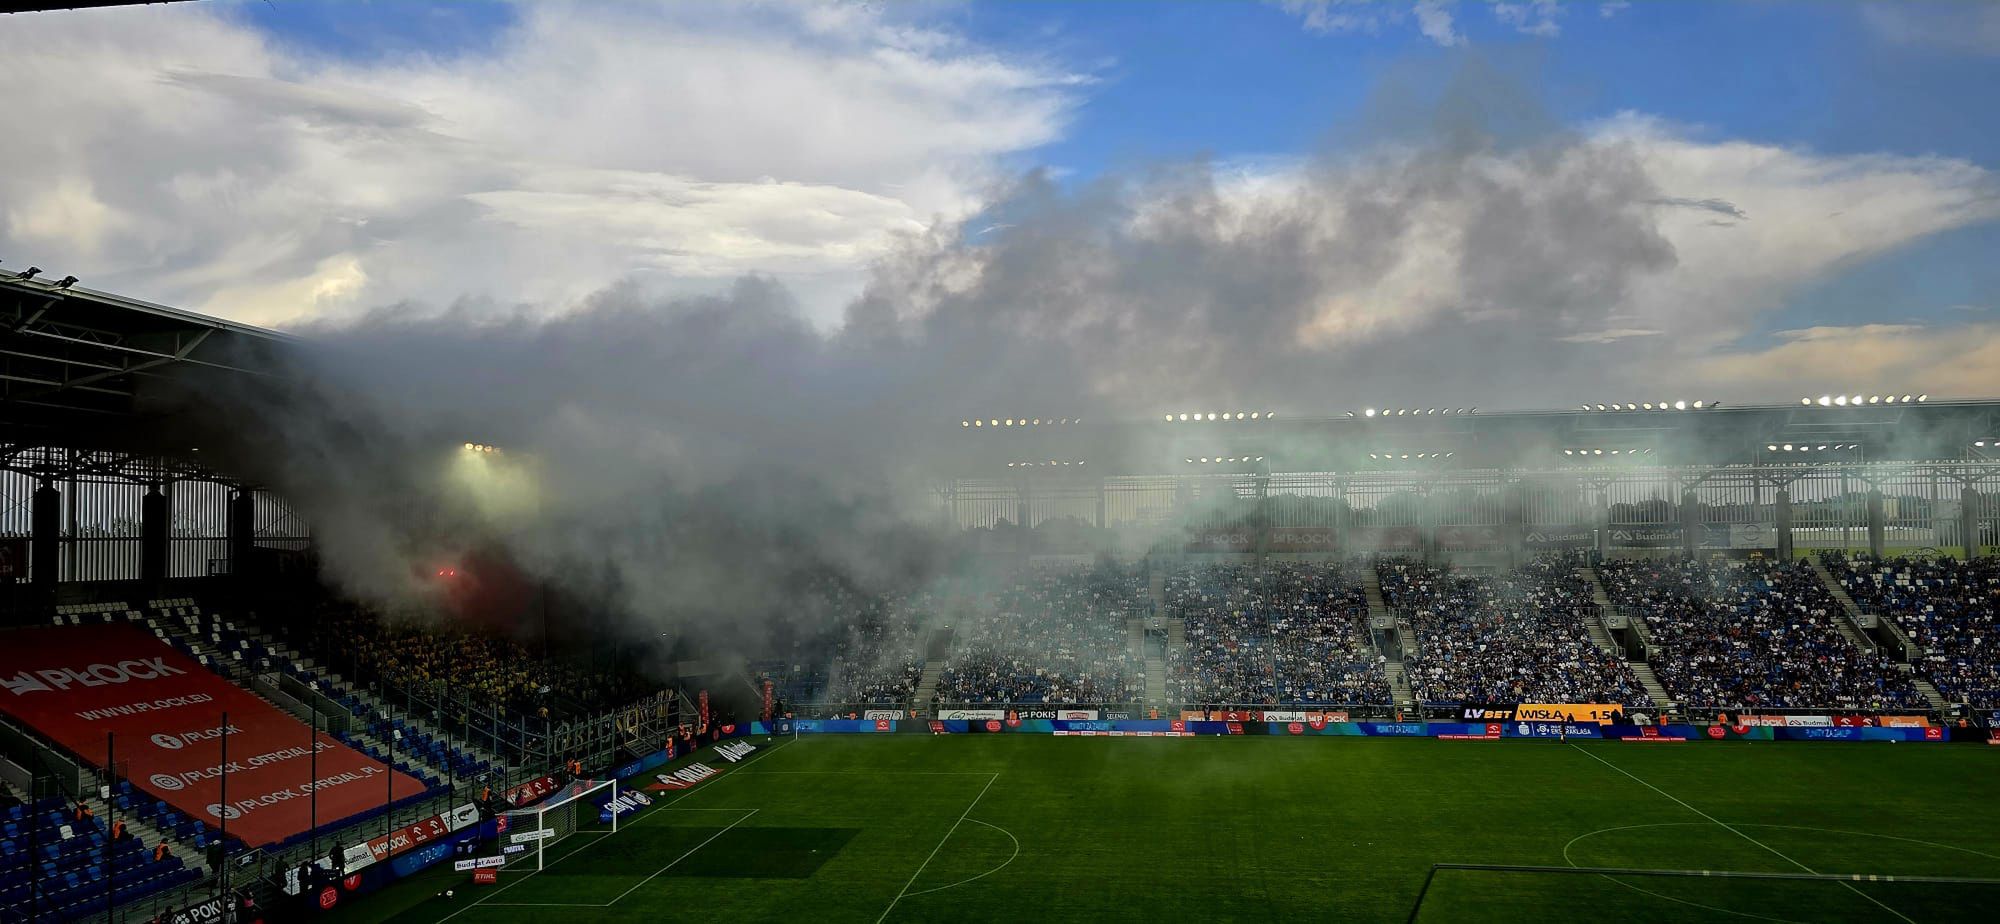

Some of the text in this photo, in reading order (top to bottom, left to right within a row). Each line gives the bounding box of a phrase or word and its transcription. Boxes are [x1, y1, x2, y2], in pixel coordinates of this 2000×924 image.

[1286, 534, 1331, 545] PŁOCK
[37, 656, 188, 690] PŁOCK
[1030, 710, 1056, 719] POKIS
[1463, 708, 1512, 719] LVBET
[1519, 709, 1565, 720] WISŁA
[456, 860, 484, 869] Budat
